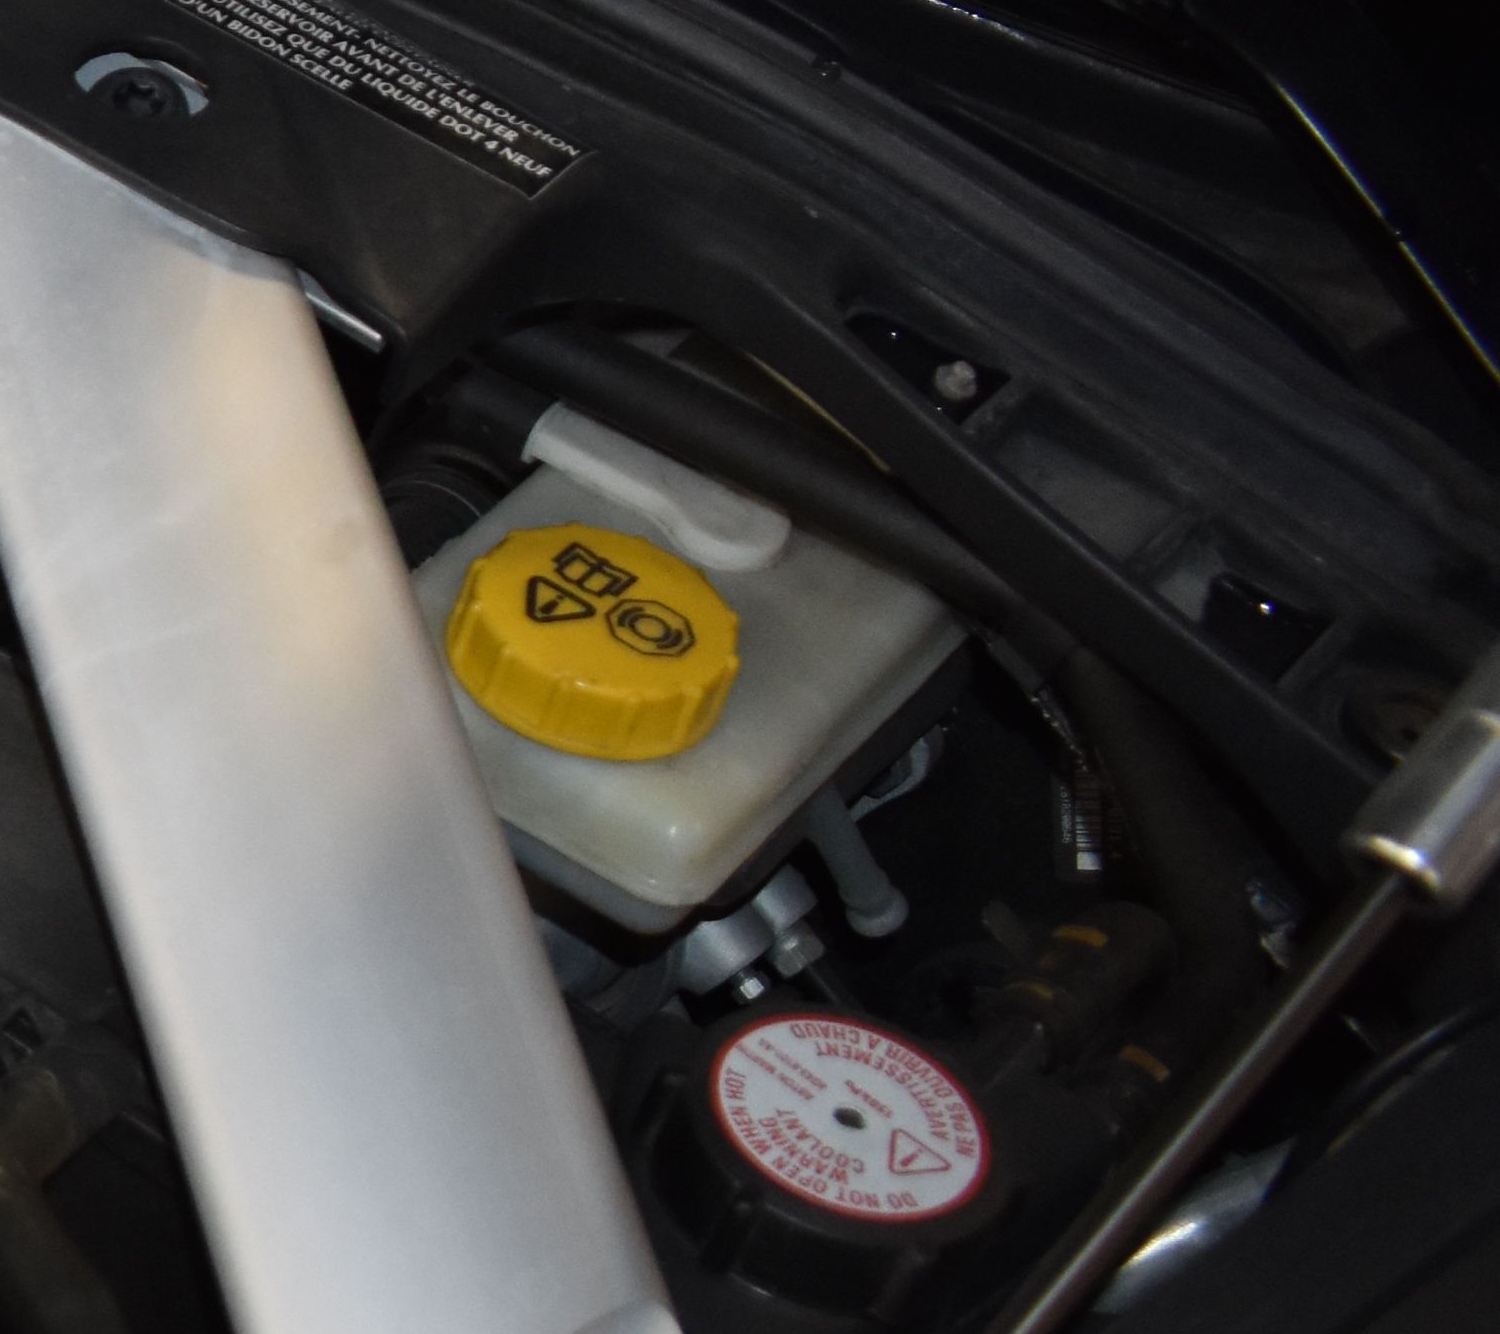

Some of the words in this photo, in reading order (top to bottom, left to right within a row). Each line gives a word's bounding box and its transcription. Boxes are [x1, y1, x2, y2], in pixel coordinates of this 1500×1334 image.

[226, 19, 291, 56] BIDON
[289, 53, 352, 90] SCELLE
[286, 33, 330, 58] QUE
[327, 54, 362, 75] DU
[360, 72, 440, 118] LIQUIDE
[438, 114, 485, 141] DOT
[483, 139, 499, 150] 4
[498, 146, 552, 176] NEUF
[331, 40, 399, 75] AVANT
[397, 73, 426, 92] DE
[425, 88, 519, 142] L'ENLEVER
[363, 38, 456, 90] NETTOYEZ
[456, 88, 477, 102] LE
[479, 100, 580, 156] BOUCHON
[789, 1023, 860, 1045] CHAUD
[866, 1034, 879, 1048] A
[725, 1068, 747, 1102] HOT
[815, 1041, 952, 1141] AVERTISSEMENT
[885, 1042, 953, 1099] OUVRIR
[728, 1104, 777, 1157] WHEN
[776, 1109, 866, 1175] COOLANT
[945, 1101, 972, 1133] PAS
[758, 1116, 849, 1184] WARNING
[955, 1136, 975, 1158] NE
[772, 1155, 828, 1195] OPEN
[835, 1186, 880, 1209] NOT
[886, 1187, 919, 1209] DO
